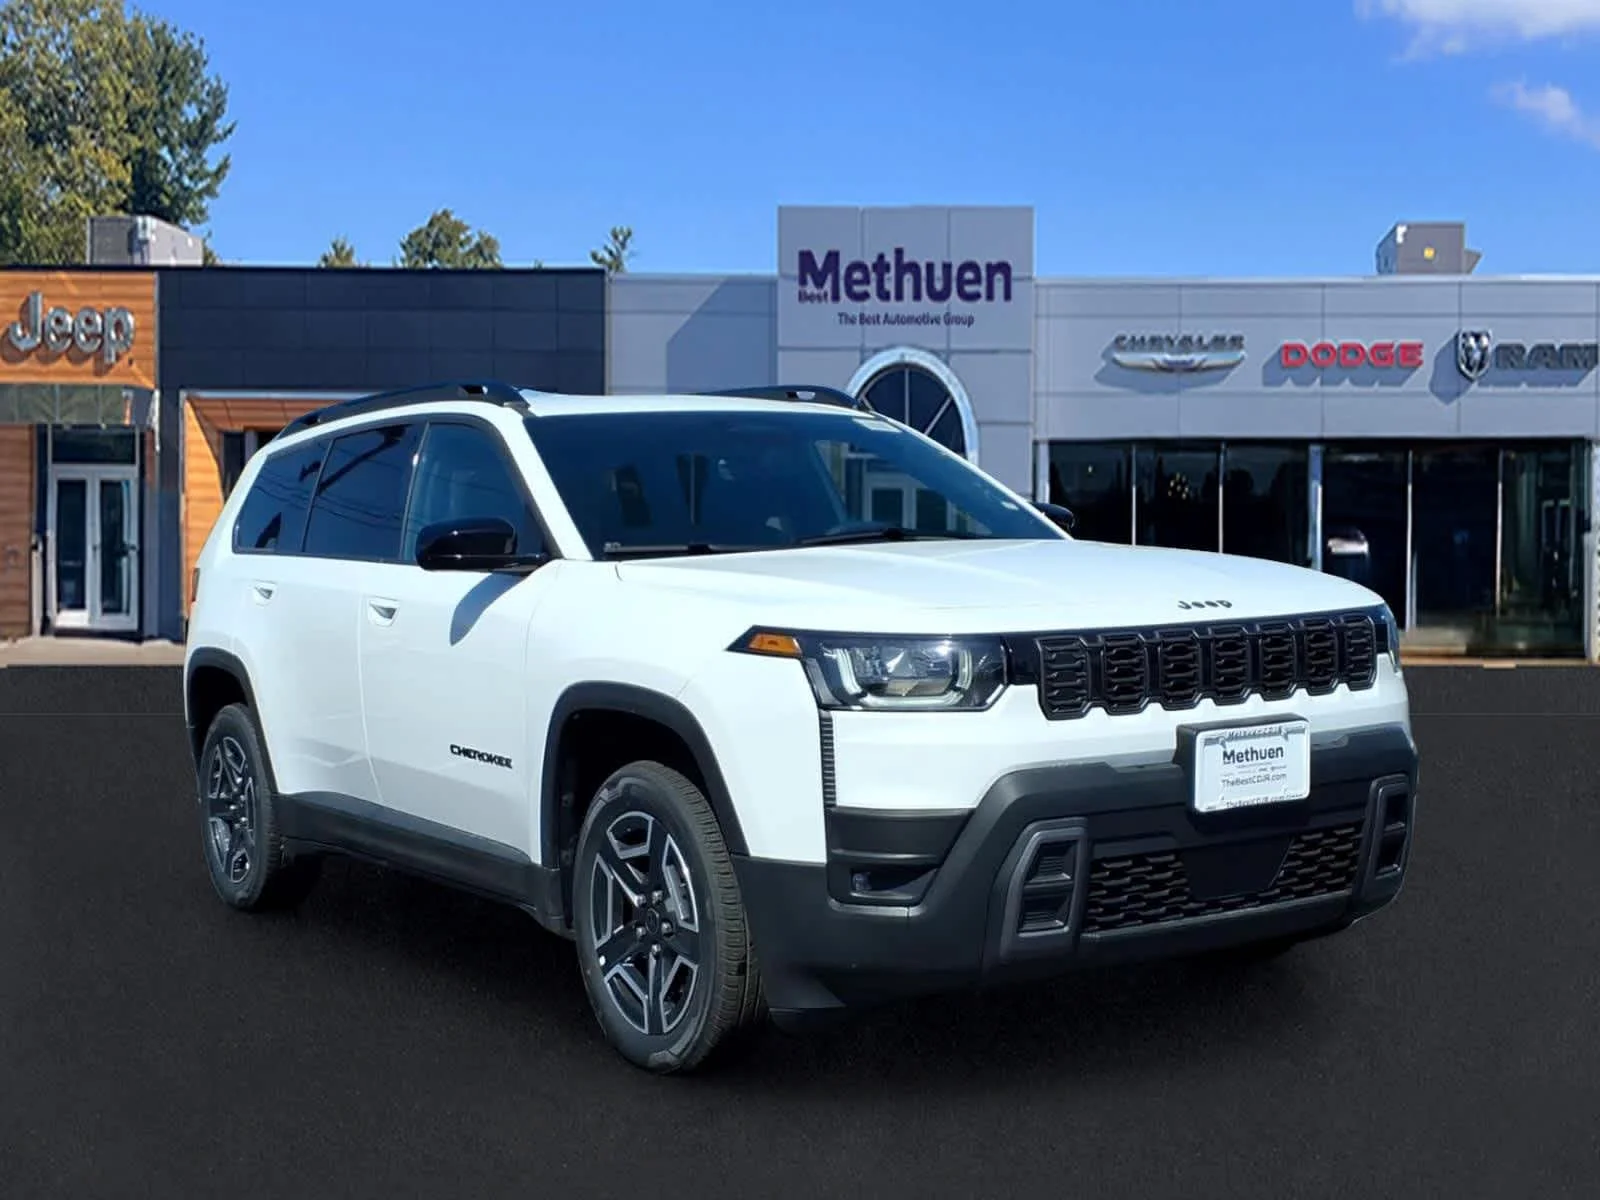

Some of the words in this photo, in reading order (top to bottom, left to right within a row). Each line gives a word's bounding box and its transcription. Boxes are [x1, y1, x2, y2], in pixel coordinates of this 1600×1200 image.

[798, 248, 1012, 303] Methuen
[798, 290, 828, 303] Best
[9, 291, 136, 363] Jeep
[838, 312, 857, 325] The
[859, 312, 880, 325] Best
[883, 312, 940, 325] Automotive
[943, 312, 974, 327] Group
[1114, 335, 1244, 352] CHRYSLER
[1281, 342, 1423, 367] DODGE
[1495, 343, 1598, 369] RAM
[1178, 600, 1233, 610] Jeep
[450, 744, 512, 769] CHEROKEE
[1223, 746, 1284, 764] Methuen
